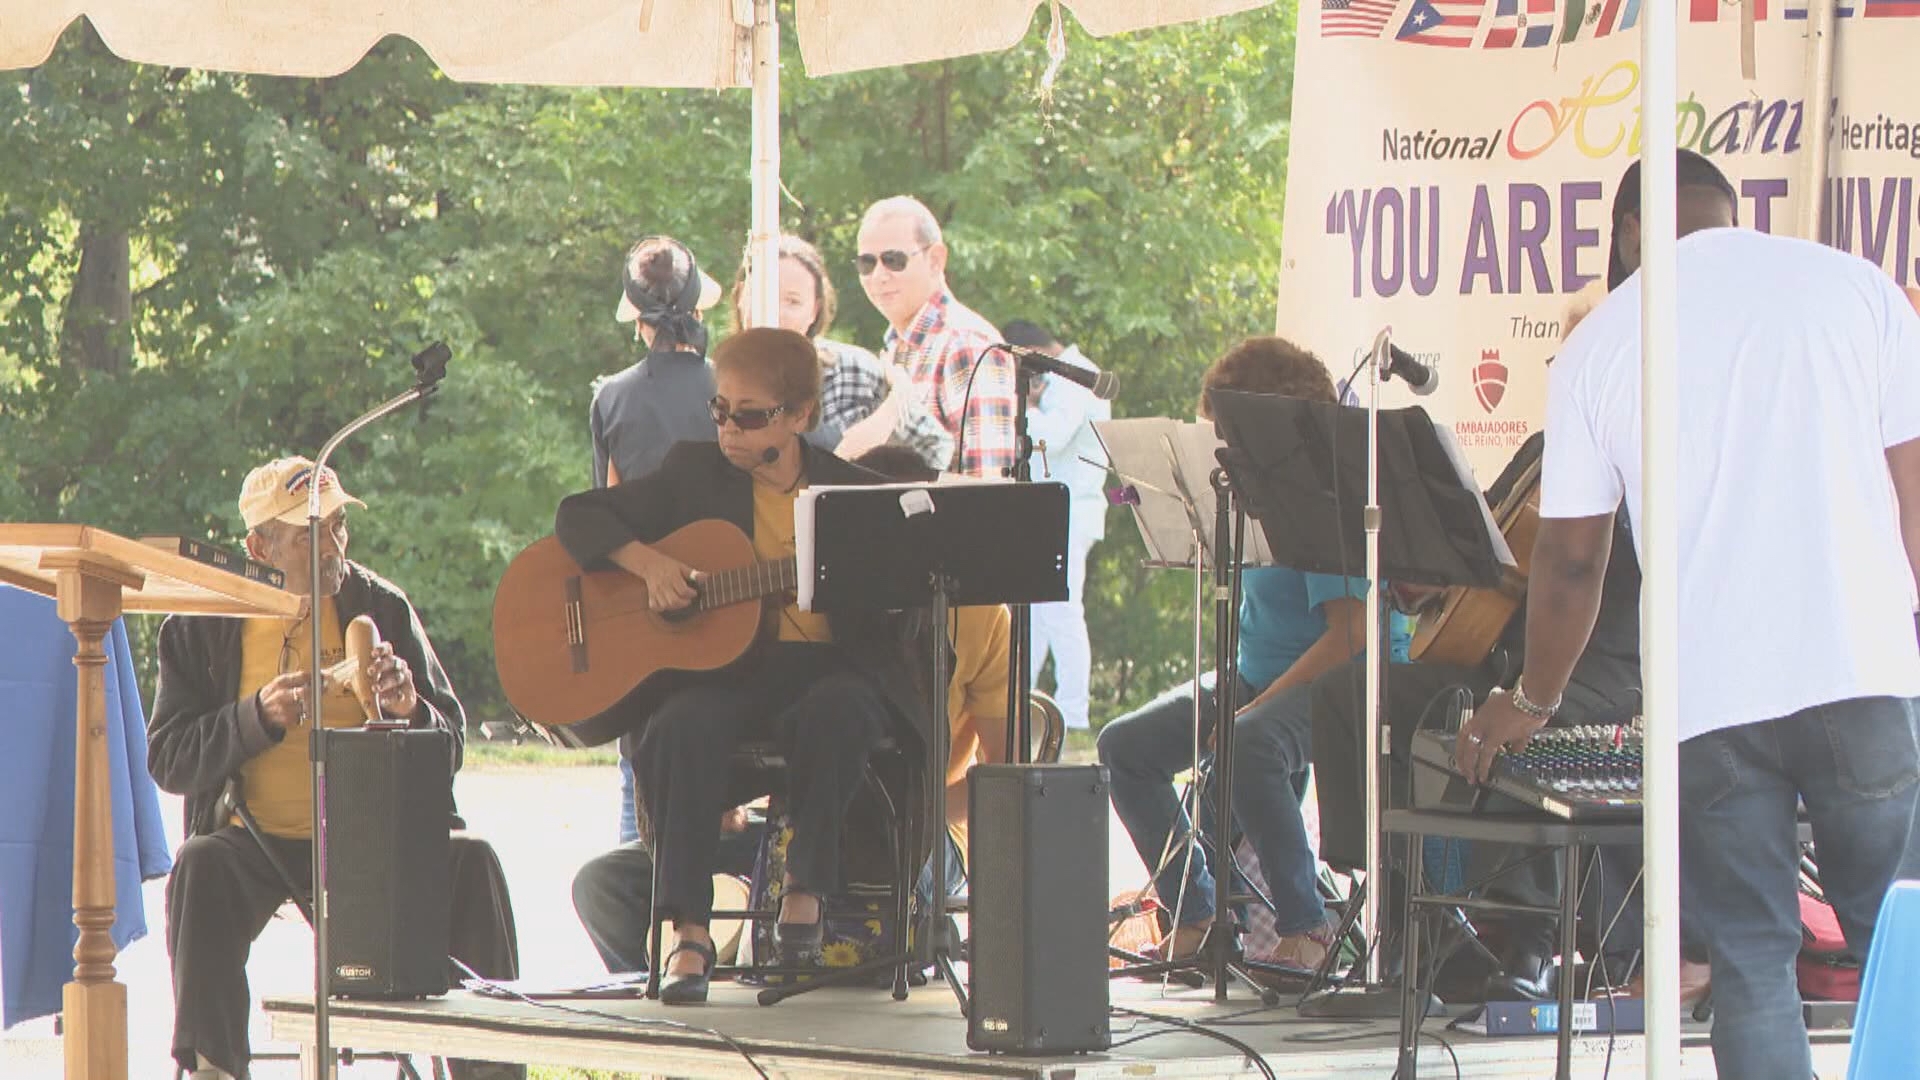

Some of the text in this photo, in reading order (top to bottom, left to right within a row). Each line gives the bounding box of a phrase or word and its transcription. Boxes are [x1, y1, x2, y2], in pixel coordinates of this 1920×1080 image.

[1382, 128, 1502, 161] National
[1459, 181, 1603, 294] ARE
[1455, 421, 1528, 434] EMBAJADORES
[1457, 434, 1472, 446] DEL
